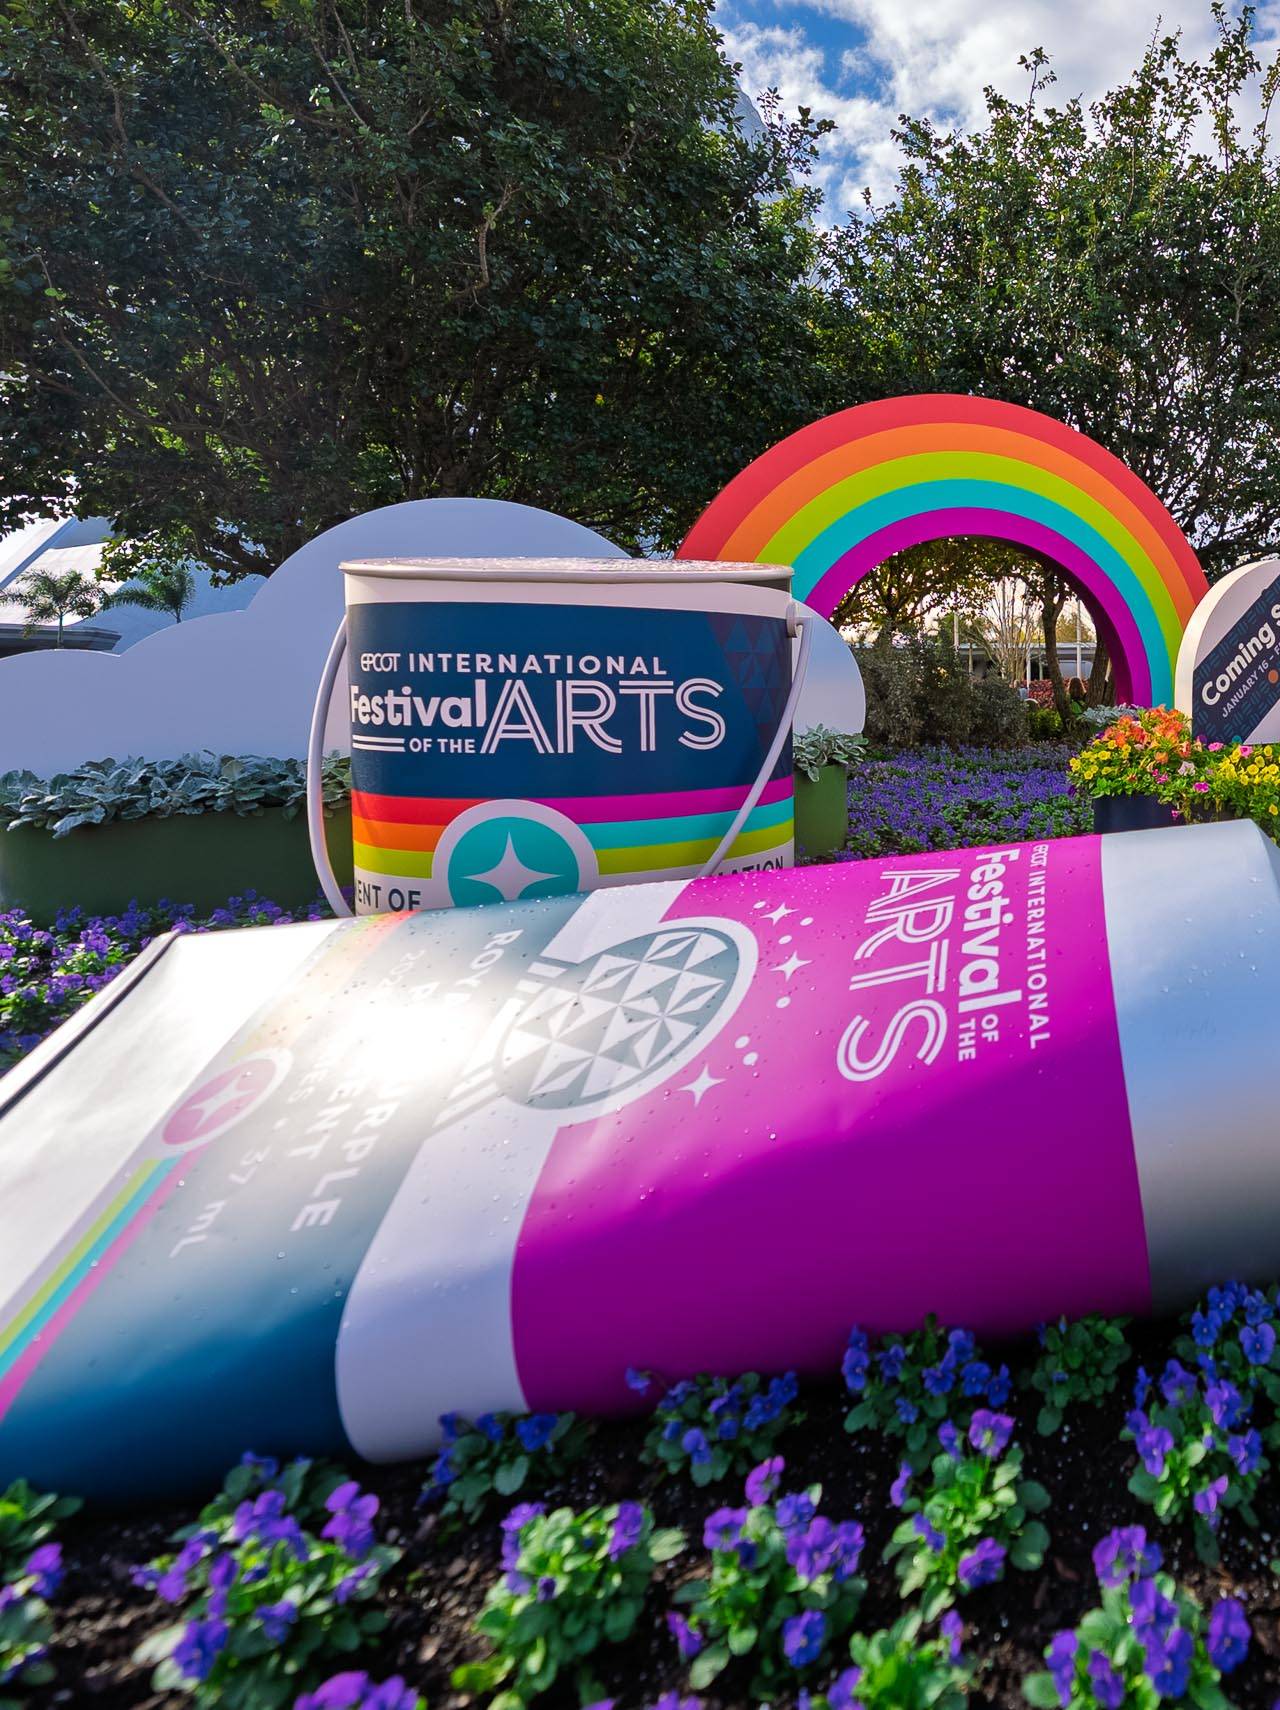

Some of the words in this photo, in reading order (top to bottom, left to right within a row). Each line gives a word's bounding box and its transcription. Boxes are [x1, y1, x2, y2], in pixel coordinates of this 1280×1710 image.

[361, 653, 401, 672] EPCOT
[409, 653, 667, 676] INTERNATIONAL
[1201, 622, 1277, 706] Coming
[1221, 672, 1259, 718] JANUARY
[1257, 659, 1270, 673] 16
[350, 679, 487, 728] Festival
[480, 678, 726, 755] ARTS
[409, 738, 432, 753] OF
[437, 738, 476, 754] THE
[388, 888, 421, 912] OF
[958, 848, 1022, 1014] Festival
[836, 868, 961, 1082] ARTS
[1026, 871, 1051, 1049] INTERNATIONAL
[958, 1018, 976, 1062] THE
[981, 1013, 999, 1043] OF
